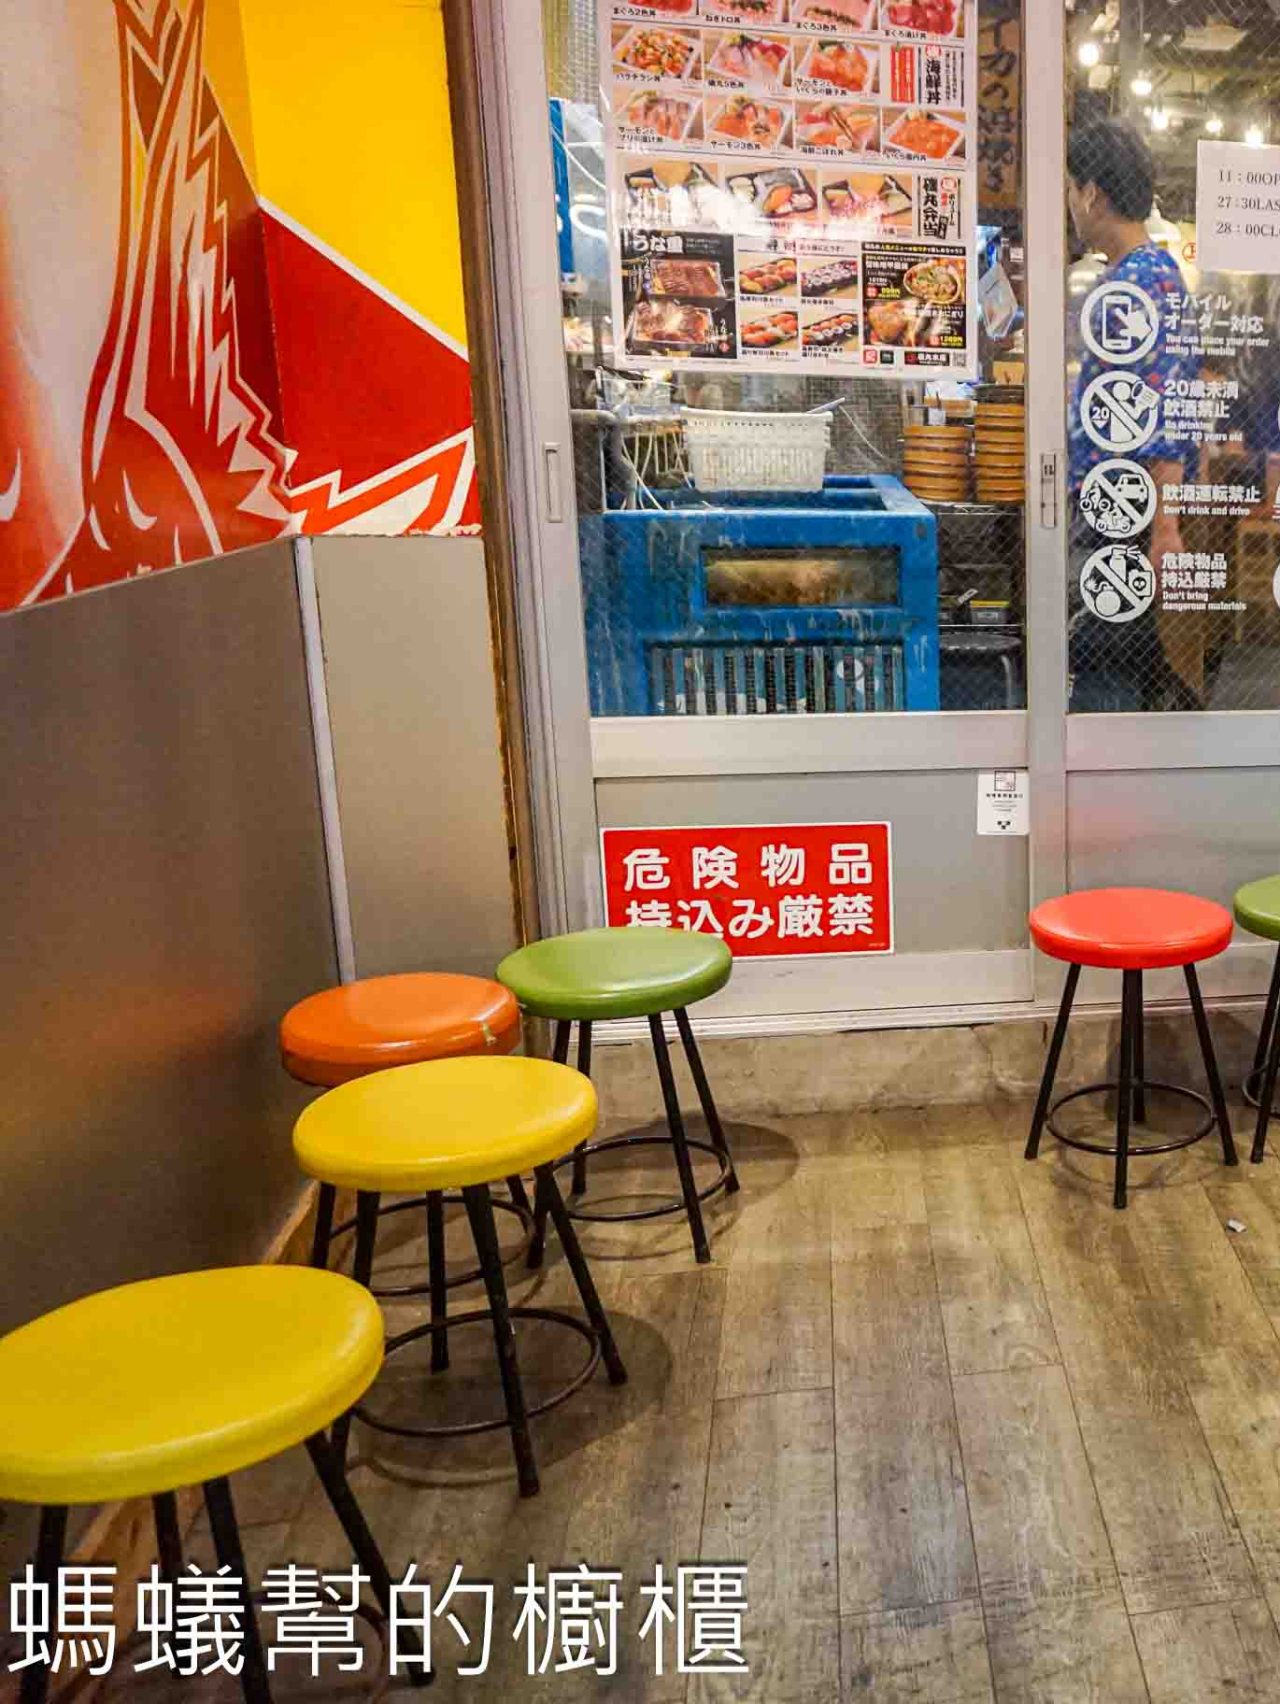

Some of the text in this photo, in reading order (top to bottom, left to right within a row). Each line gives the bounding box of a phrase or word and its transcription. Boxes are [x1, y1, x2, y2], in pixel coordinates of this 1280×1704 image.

[926, 58, 942, 105] 海鮮丼
[1166, 292, 1232, 312] モバイル
[1164, 312, 1265, 334] オーダー対応
[1166, 335, 1181, 344] You
[1201, 335, 1224, 346] place
[1226, 338, 1246, 347] your
[1248, 337, 1270, 346] order
[1164, 379, 1239, 399] 20歳未満
[1163, 399, 1230, 418] 飲酒禁止
[1165, 420, 1214, 431] No drinking
[1165, 432, 1243, 443] under 20 years old
[1162, 484, 1261, 503] 飲酒運転禁止
[1163, 505, 1251, 516] Don't drink and drive
[1161, 552, 1228, 570] 危険物品
[1161, 571, 1227, 590] 持込厳禁
[1162, 591, 1209, 602] Don't bring
[1162, 601, 1247, 612] dangerous materials
[623, 843, 872, 891] 危険物品
[625, 893, 873, 939] 持込み厳禁
